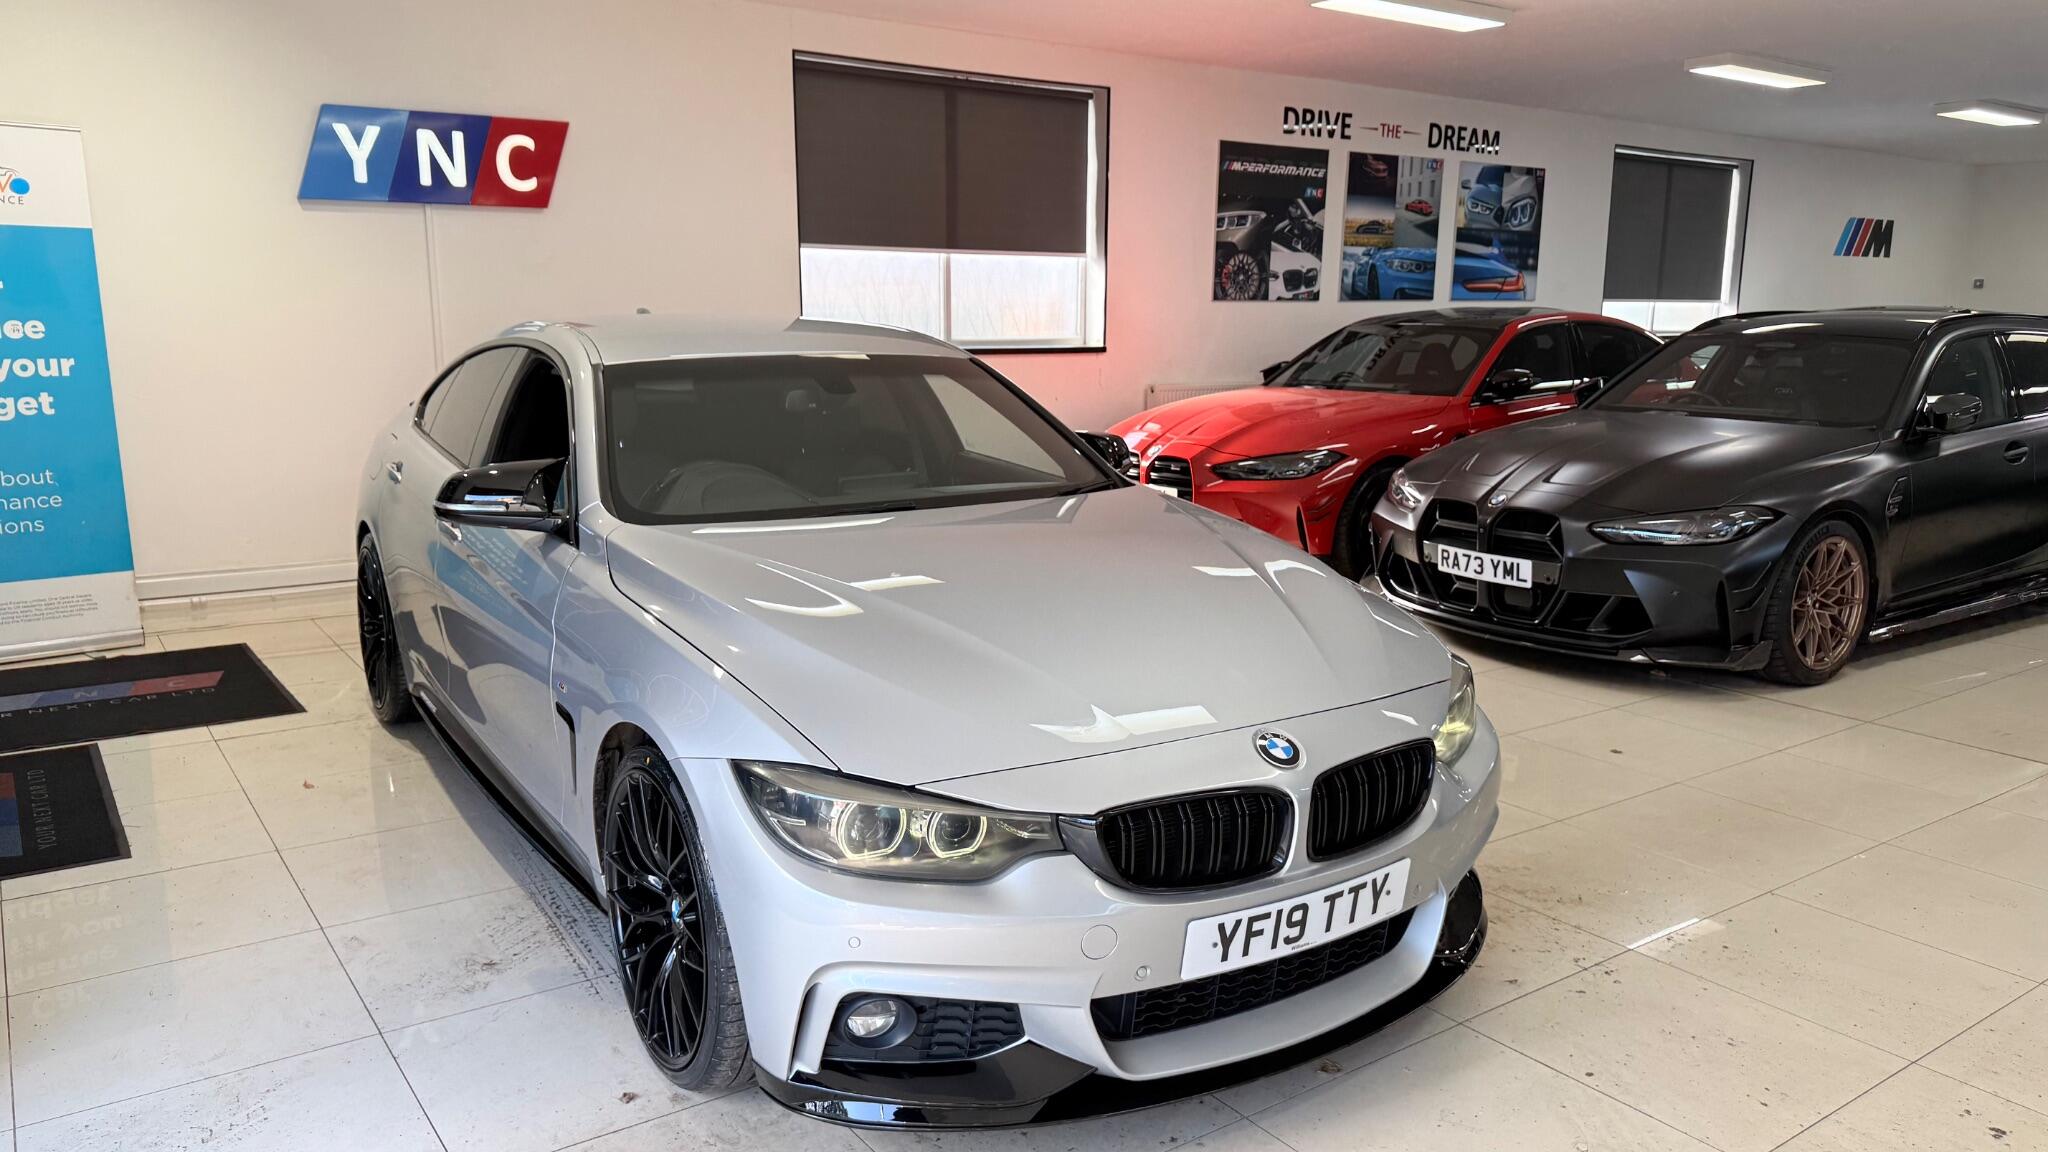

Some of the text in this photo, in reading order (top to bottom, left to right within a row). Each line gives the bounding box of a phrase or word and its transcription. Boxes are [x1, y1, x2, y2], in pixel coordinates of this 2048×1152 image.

[1283, 106, 1501, 155] DRIVE THE DREAM
[332, 122, 538, 192] YNC
[0, 357, 75, 383] your
[1440, 549, 1528, 583] RA73 YML
[1217, 872, 1390, 963] YF19 TTY
